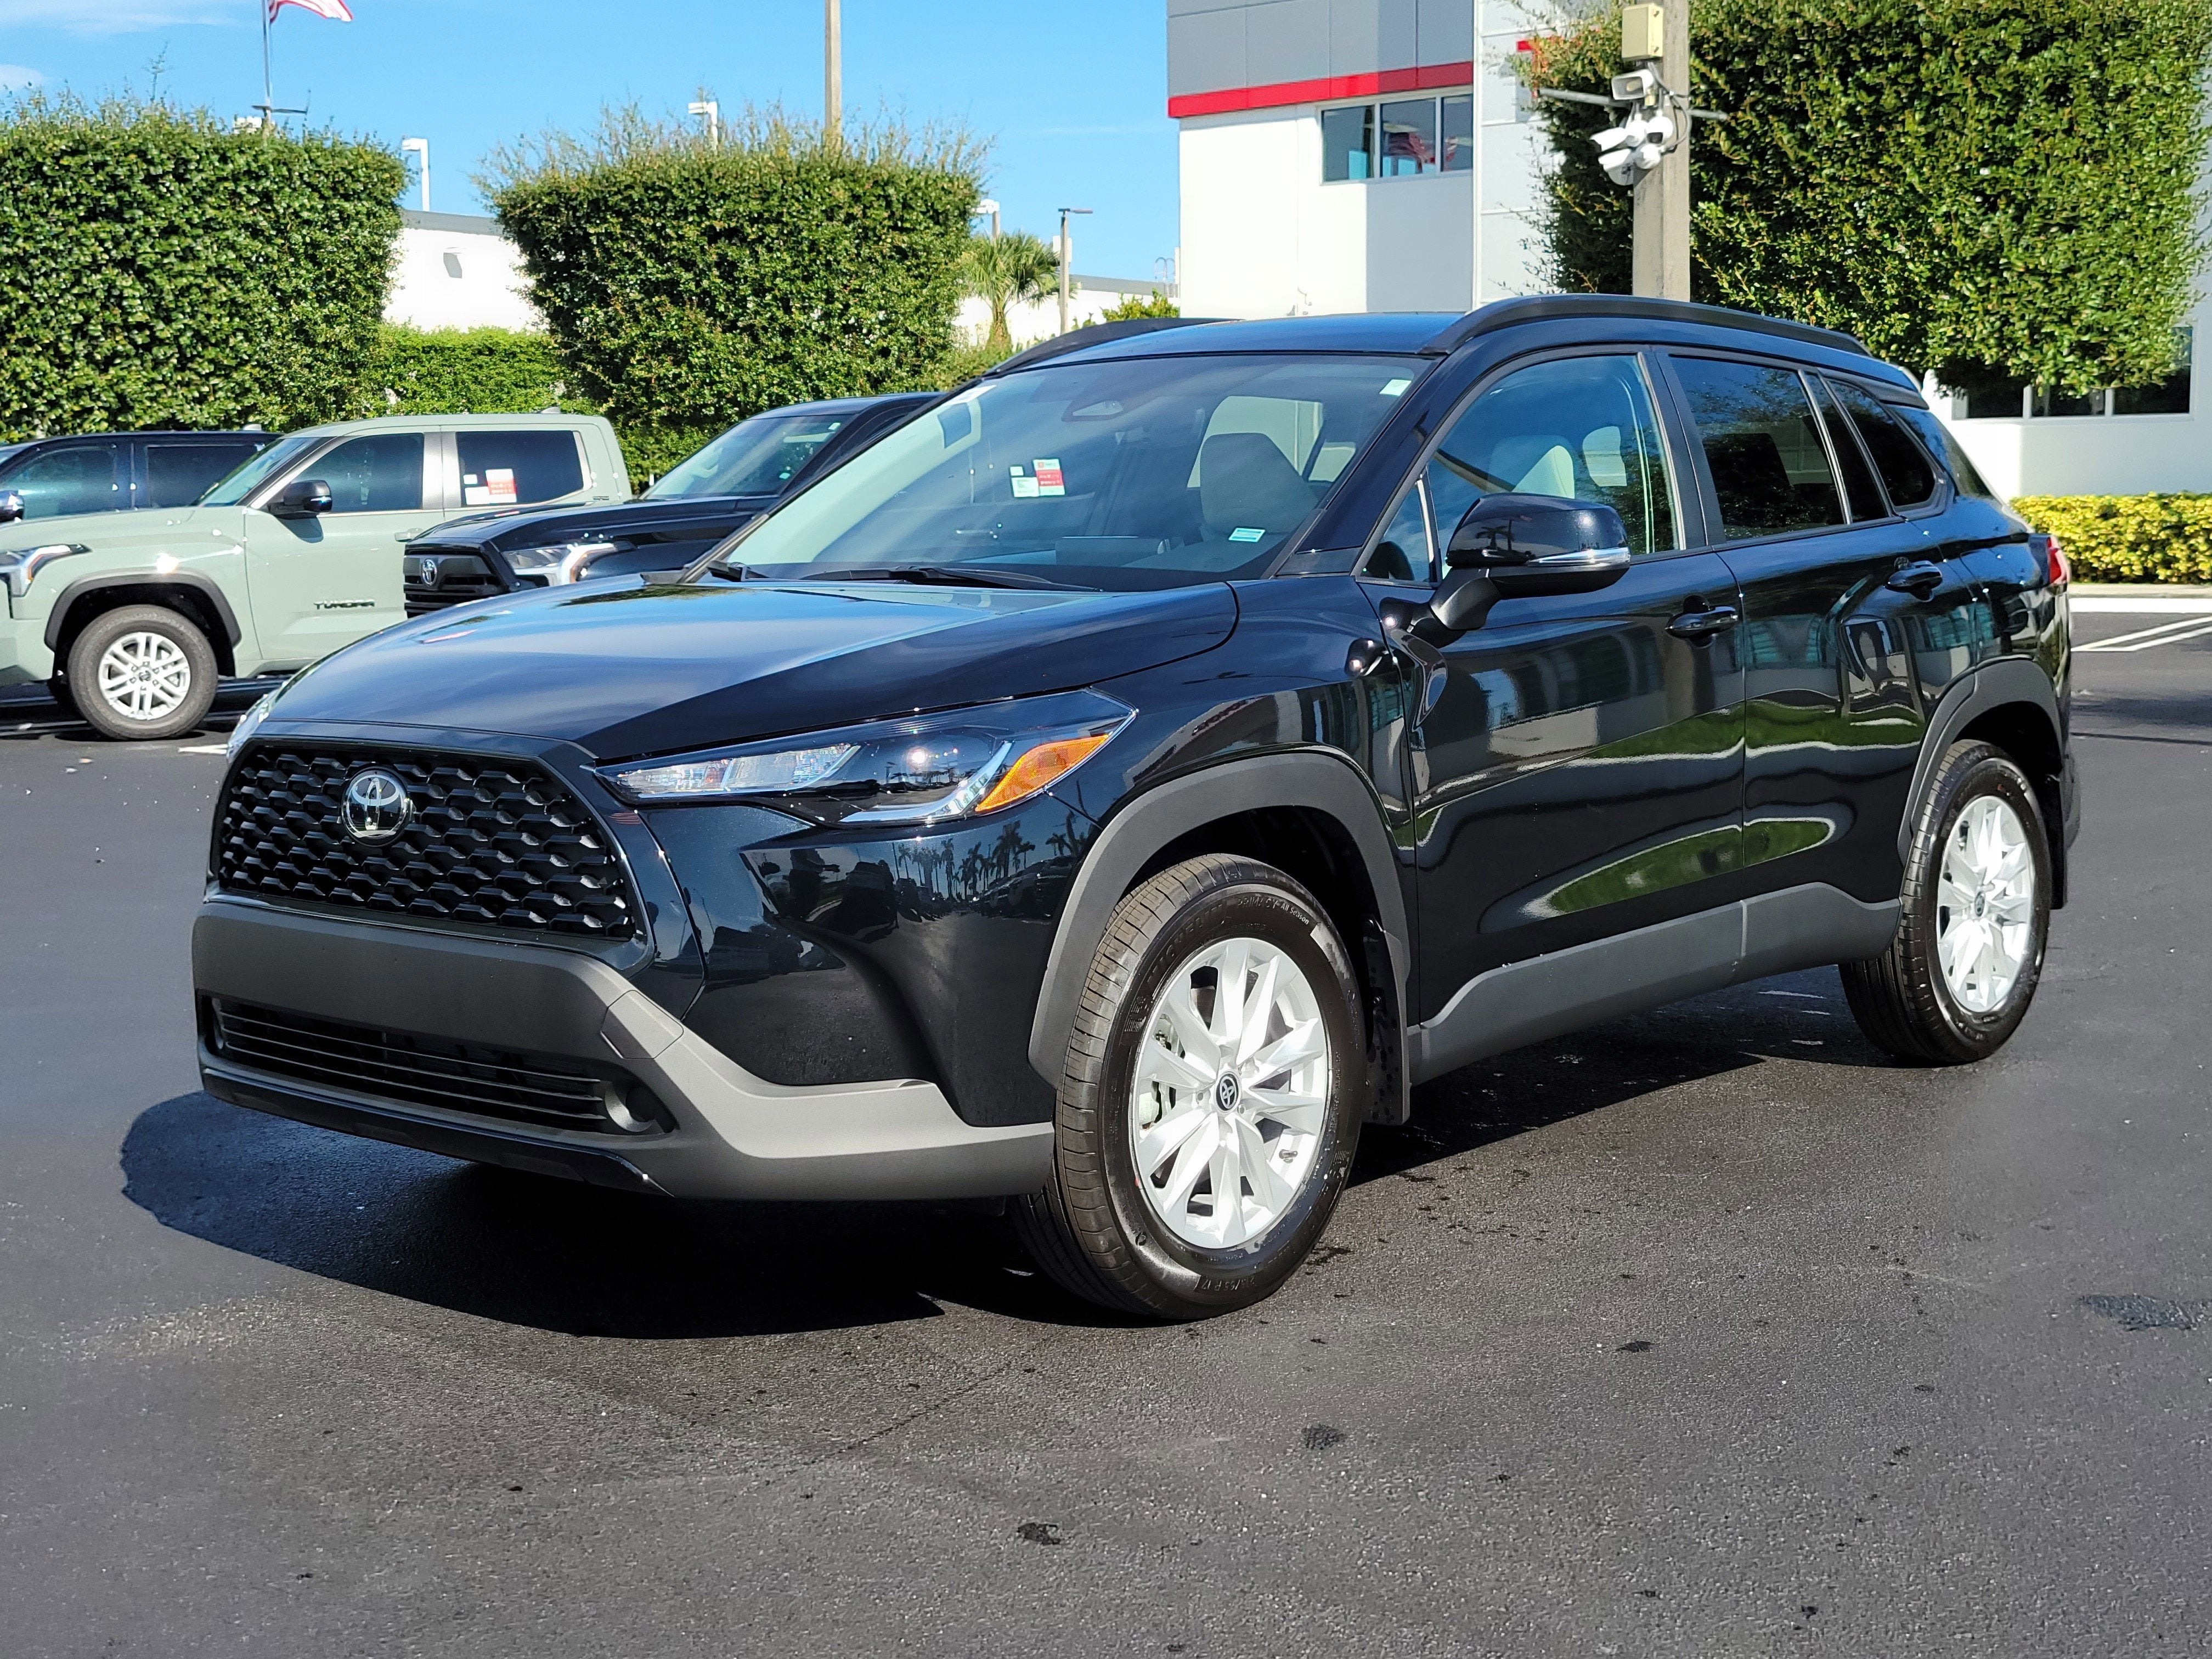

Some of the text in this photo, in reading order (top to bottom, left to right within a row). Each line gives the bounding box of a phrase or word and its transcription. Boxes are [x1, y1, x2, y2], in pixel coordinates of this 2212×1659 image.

[313, 599, 375, 610] TUNDRA
[1280, 903, 1290, 911] All
[1290, 907, 1310, 925] Season
